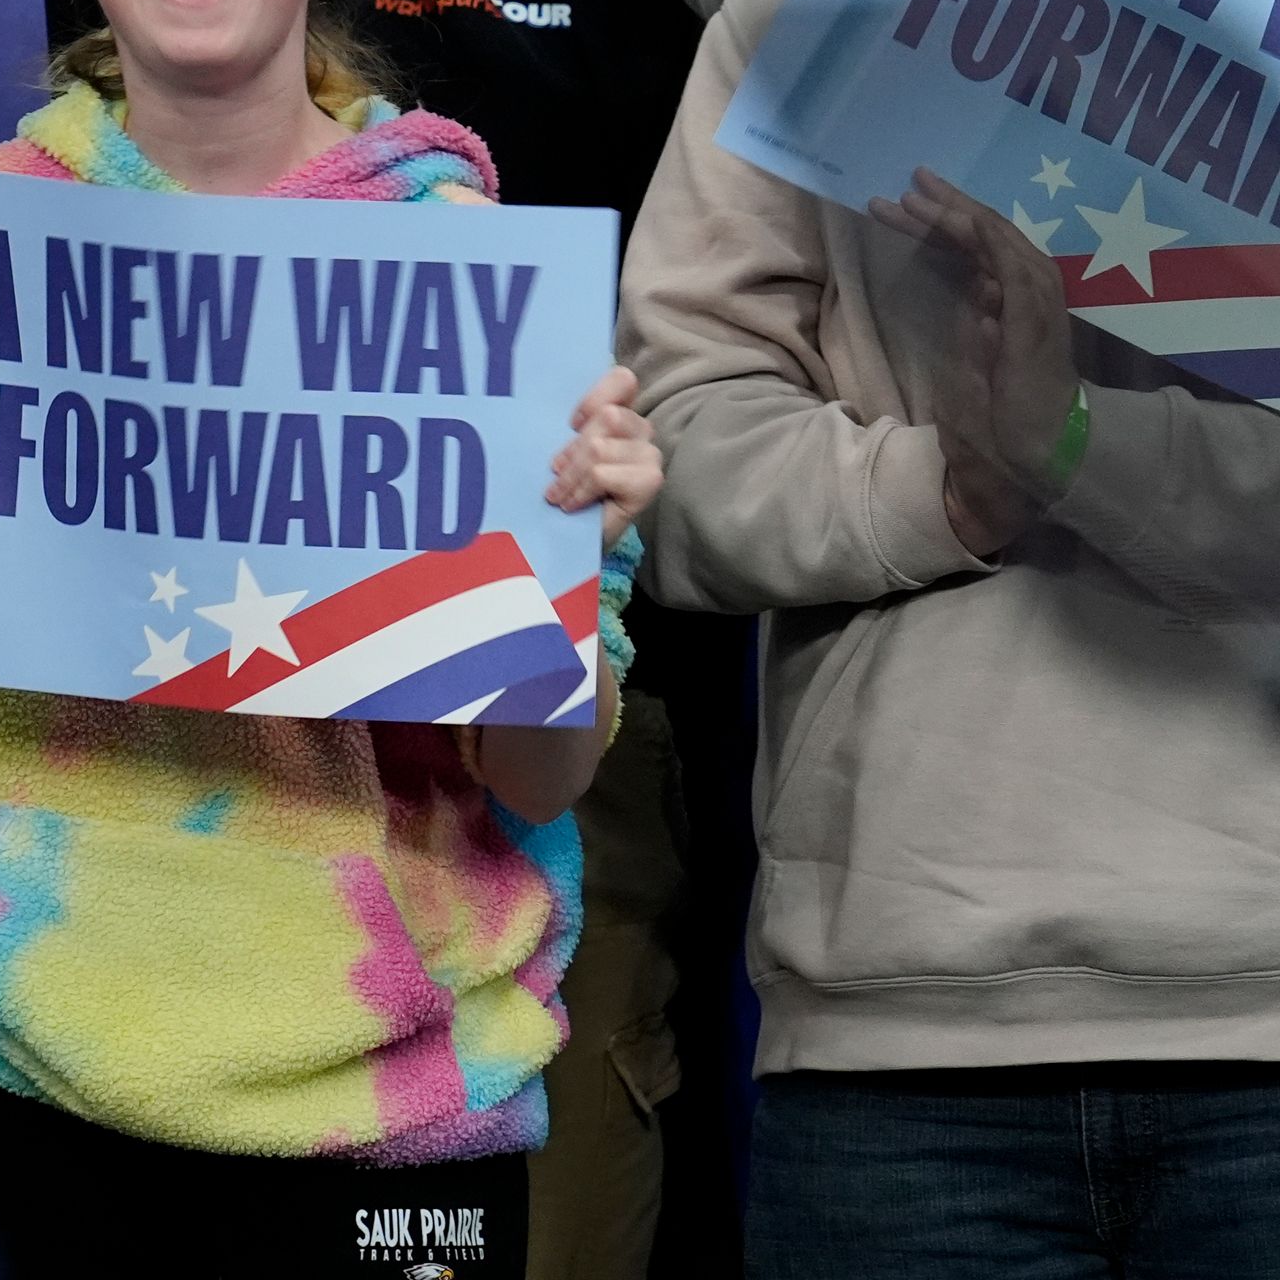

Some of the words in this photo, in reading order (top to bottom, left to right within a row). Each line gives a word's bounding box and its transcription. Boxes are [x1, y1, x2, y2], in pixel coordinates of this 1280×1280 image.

[45, 236, 262, 388] NEW
[288, 257, 542, 397] WAY
[355, 1208, 414, 1247] SAUK
[419, 1208, 485, 1247] PRAIRIE
[359, 1248, 414, 1261] TRACK
[446, 1247, 485, 1261] FIELD
